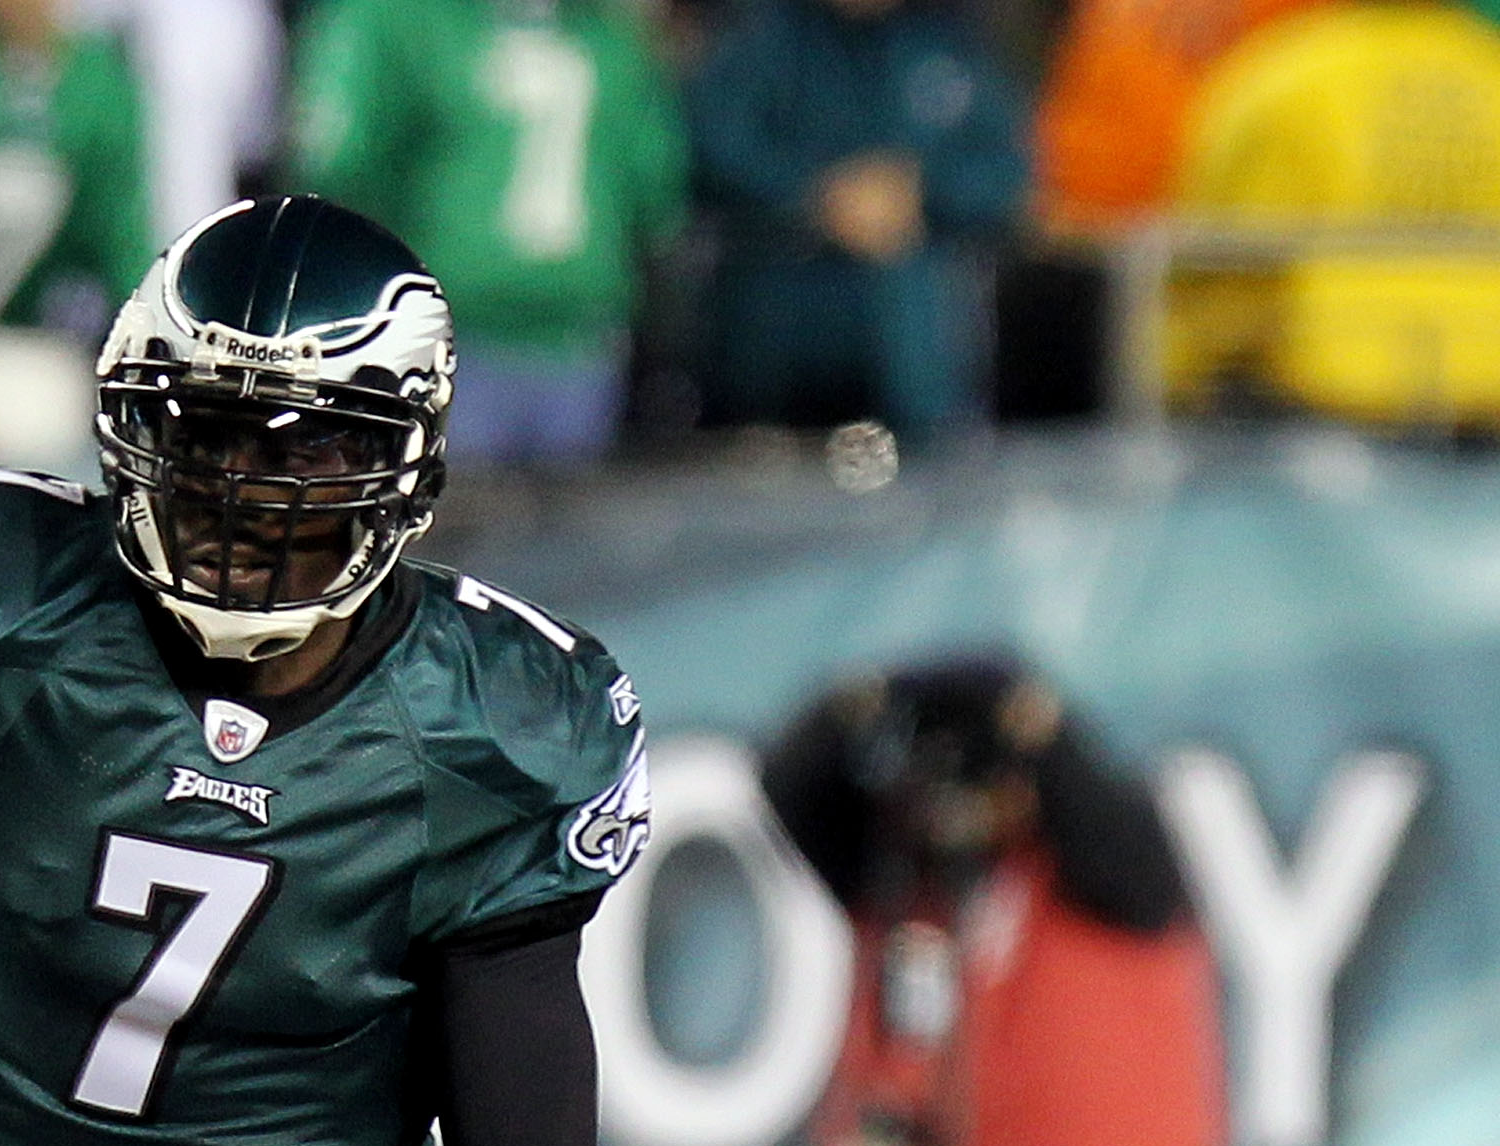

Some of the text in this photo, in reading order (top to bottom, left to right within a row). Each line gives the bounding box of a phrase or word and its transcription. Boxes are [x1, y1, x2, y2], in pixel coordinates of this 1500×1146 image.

[226, 337, 295, 363] Ridde
[456, 574, 577, 653] 7
[164, 766, 276, 825] EAGLES
[73, 833, 272, 1116] 7
